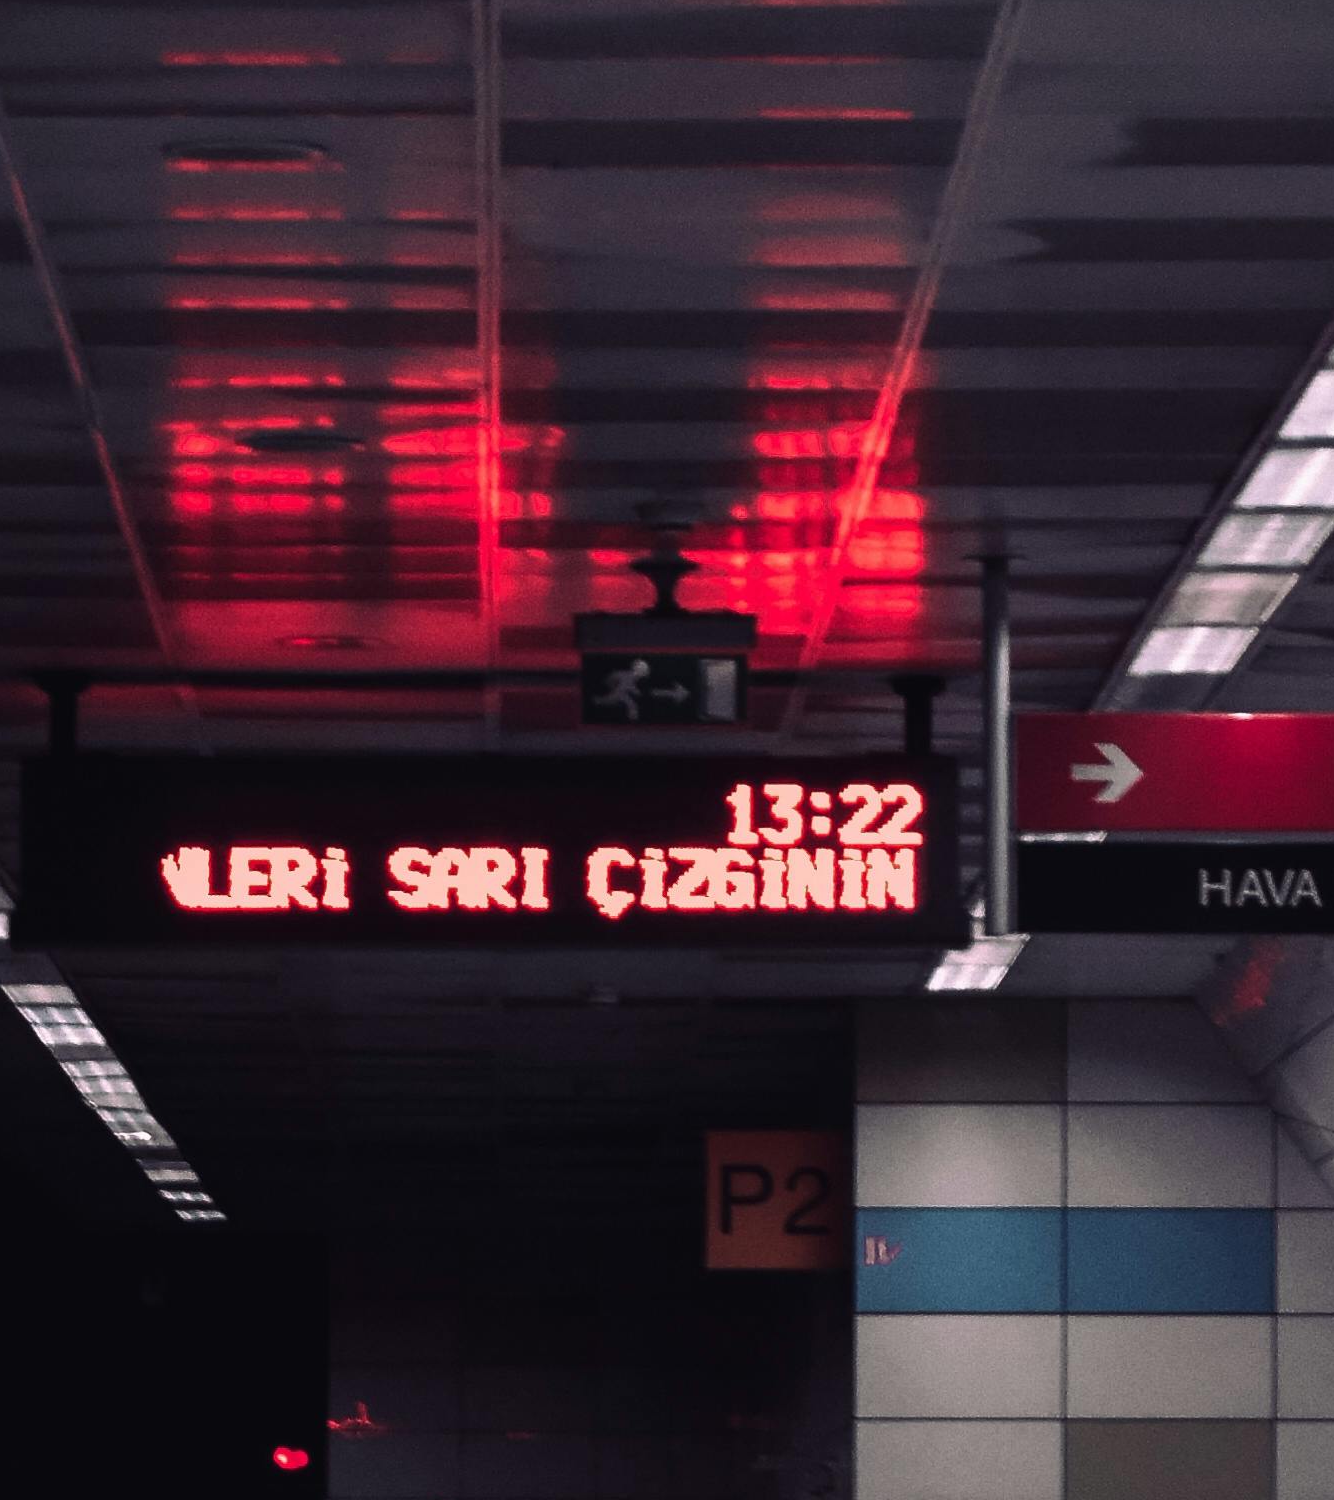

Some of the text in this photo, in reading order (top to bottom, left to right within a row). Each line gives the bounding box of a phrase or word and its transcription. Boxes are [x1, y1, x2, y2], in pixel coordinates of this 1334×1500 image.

[725, 783, 924, 847] 13:22
[385, 846, 551, 911] SARI
[586, 846, 917, 920] ÇİZGİNİN
[1197, 867, 1324, 908] HAVA
[721, 1164, 830, 1234] P2
